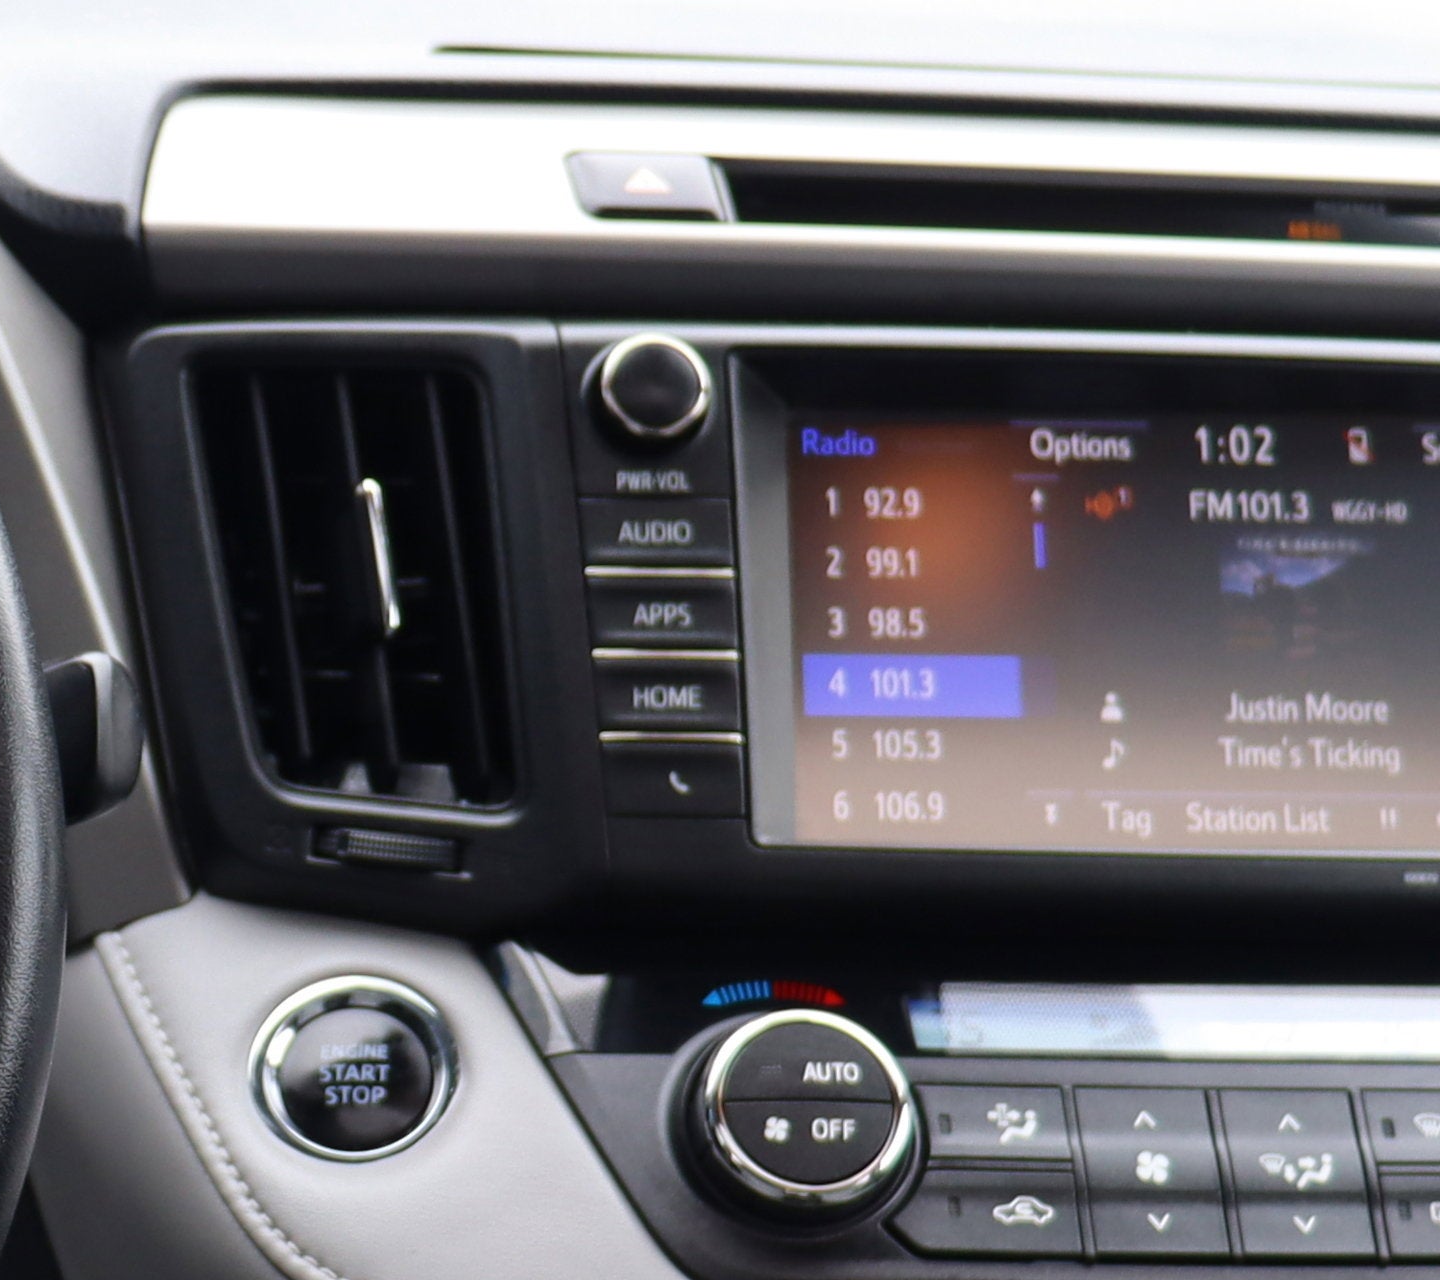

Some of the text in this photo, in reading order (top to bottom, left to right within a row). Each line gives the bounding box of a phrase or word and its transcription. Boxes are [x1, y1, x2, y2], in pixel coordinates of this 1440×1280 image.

[801, 427, 877, 456] Radio
[1029, 426, 1134, 465] Options
[1193, 425, 1276, 465] 1:02
[825, 487, 922, 518] 1 92.9
[618, 521, 693, 544] AUDIO
[825, 547, 919, 579] 2 99.1
[633, 602, 692, 626] APPS
[828, 607, 926, 638] 3 98.5
[632, 684, 703, 709] HOME
[828, 668, 936, 698] 4 101.3
[1225, 692, 1389, 724] Justin Moore
[831, 728, 943, 759] 5 105.3
[1217, 736, 1402, 775] Time's Ticking
[832, 790, 945, 821] 6 106.9
[1100, 802, 1153, 836] Tag
[1185, 802, 1279, 834] Station
[1284, 802, 1331, 834] List
[319, 1043, 389, 1060] ENGINE
[318, 1062, 391, 1083] START
[802, 1060, 862, 1085] AUTO
[323, 1084, 388, 1106] STOP
[810, 1116, 857, 1143] OFF
